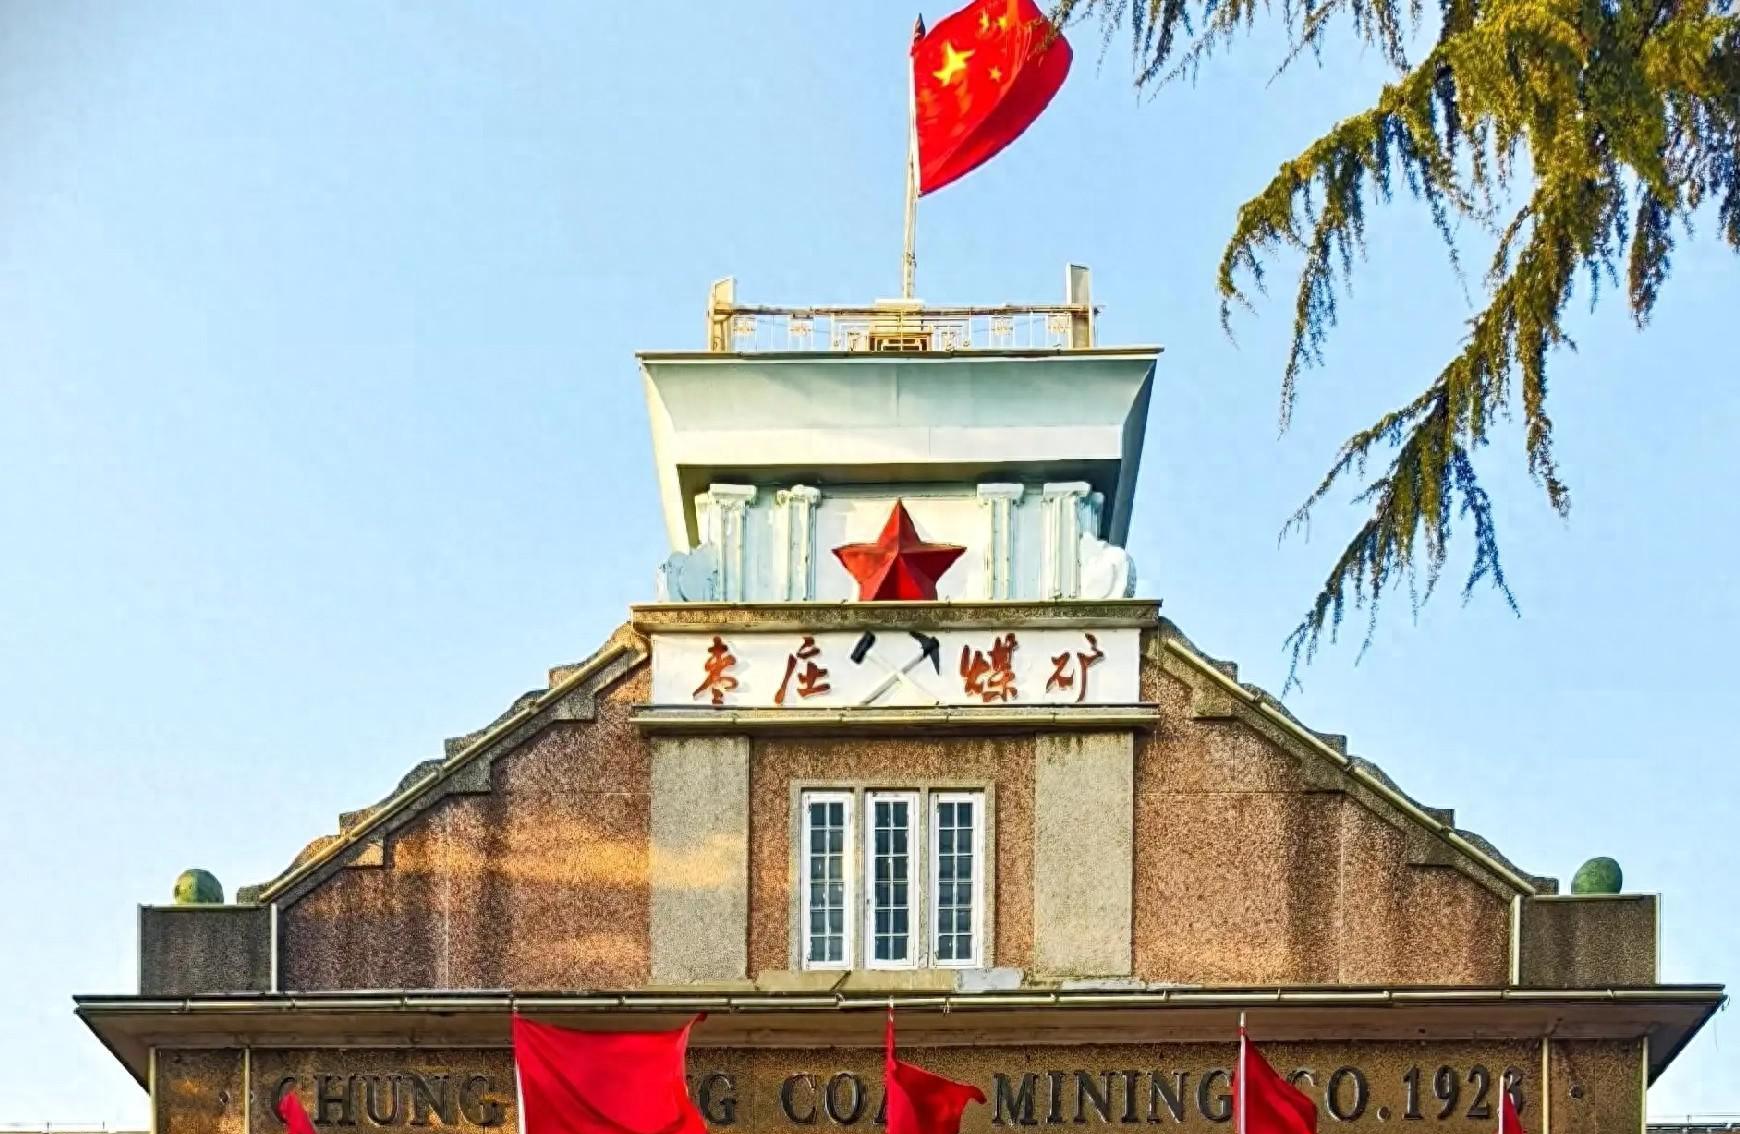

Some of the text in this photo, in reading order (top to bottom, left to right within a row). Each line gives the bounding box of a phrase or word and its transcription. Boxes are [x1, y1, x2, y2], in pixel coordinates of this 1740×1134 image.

[692, 632, 1104, 706] 枣庄 煤矿
[270, 1071, 500, 1127] CHUNG
[991, 1069, 1233, 1127] MINING
